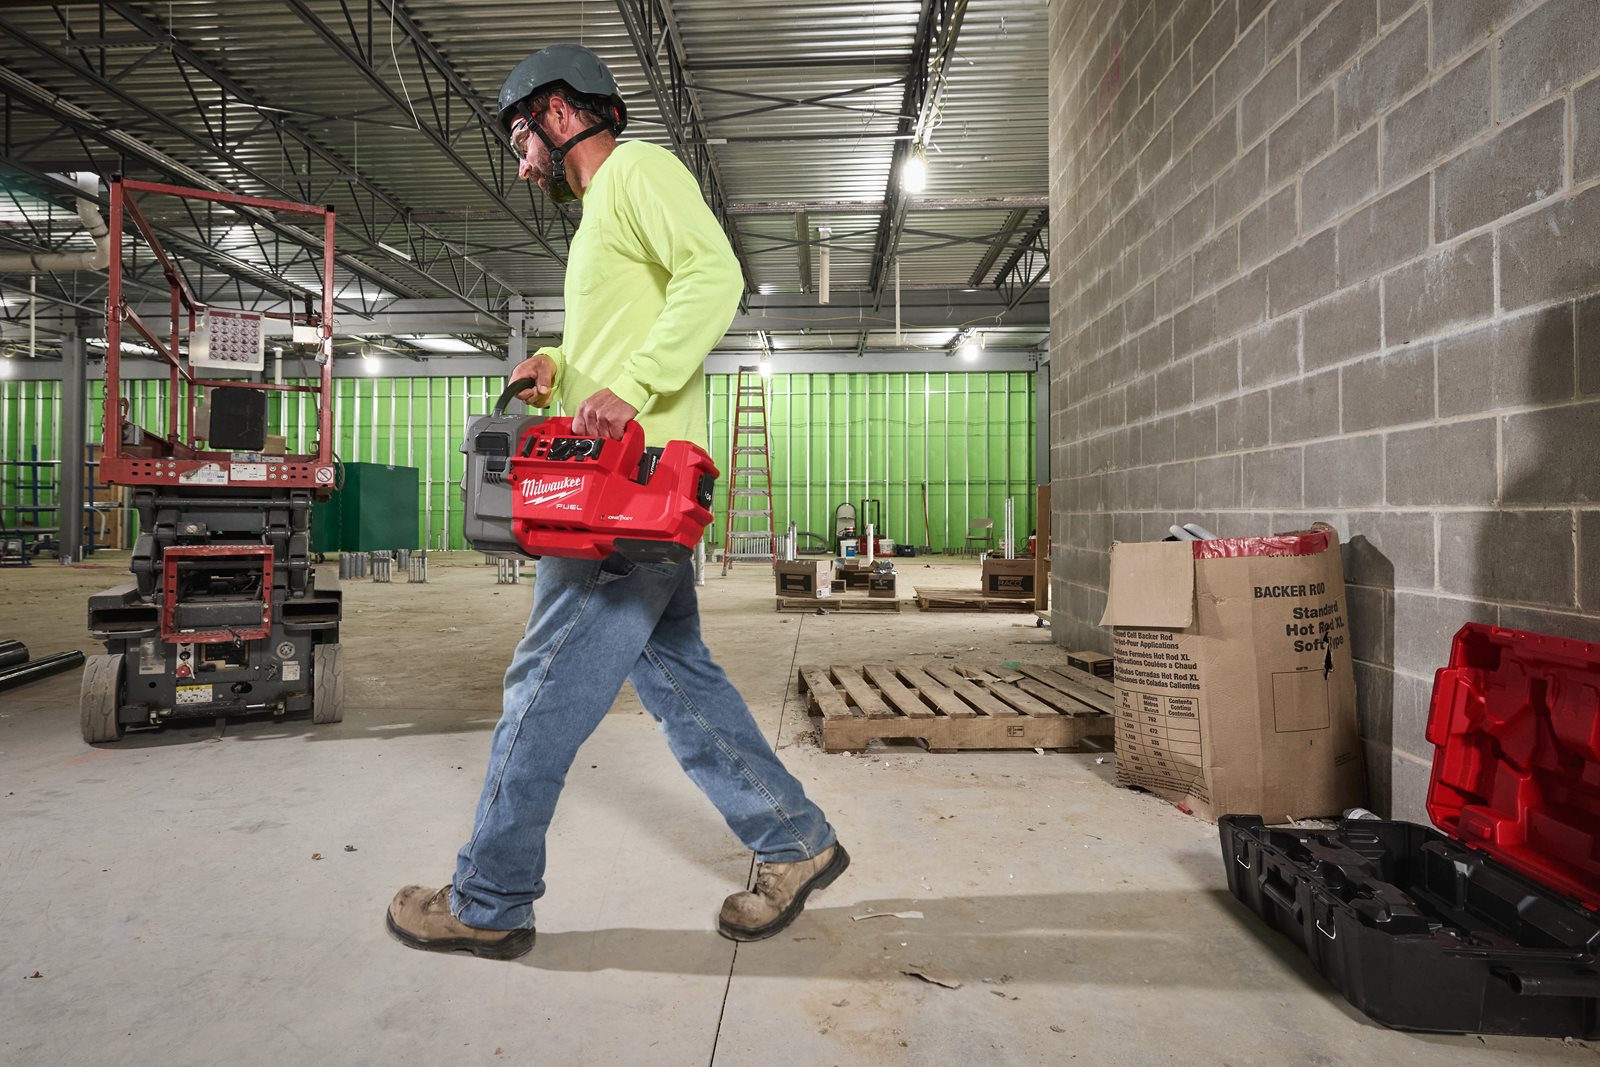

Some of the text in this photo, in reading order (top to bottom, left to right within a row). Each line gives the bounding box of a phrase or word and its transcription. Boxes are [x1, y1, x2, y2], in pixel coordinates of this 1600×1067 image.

[521, 476, 582, 497] Milwaukee
[1254, 582, 1326, 598] BACKER ROD
[1293, 600, 1338, 620] Standard
[1286, 616, 1344, 636] Hot Rod XL
[1138, 632, 1158, 640] Backer
[1140, 640, 1179, 650] Applications
[1294, 638, 1326, 652] Soft
[1129, 650, 1152, 660] Fermées
[1154, 652, 1164, 660] Hot
[1144, 660, 1168, 669] Coulées
[1174, 662, 1198, 670] Chaud
[1135, 669, 1160, 679] Cerradas
[1174, 673, 1188, 681] Rod
[1190, 674, 1200, 682] XL
[1146, 679, 1168, 688] Coladas
[1170, 682, 1200, 690] Calientes
